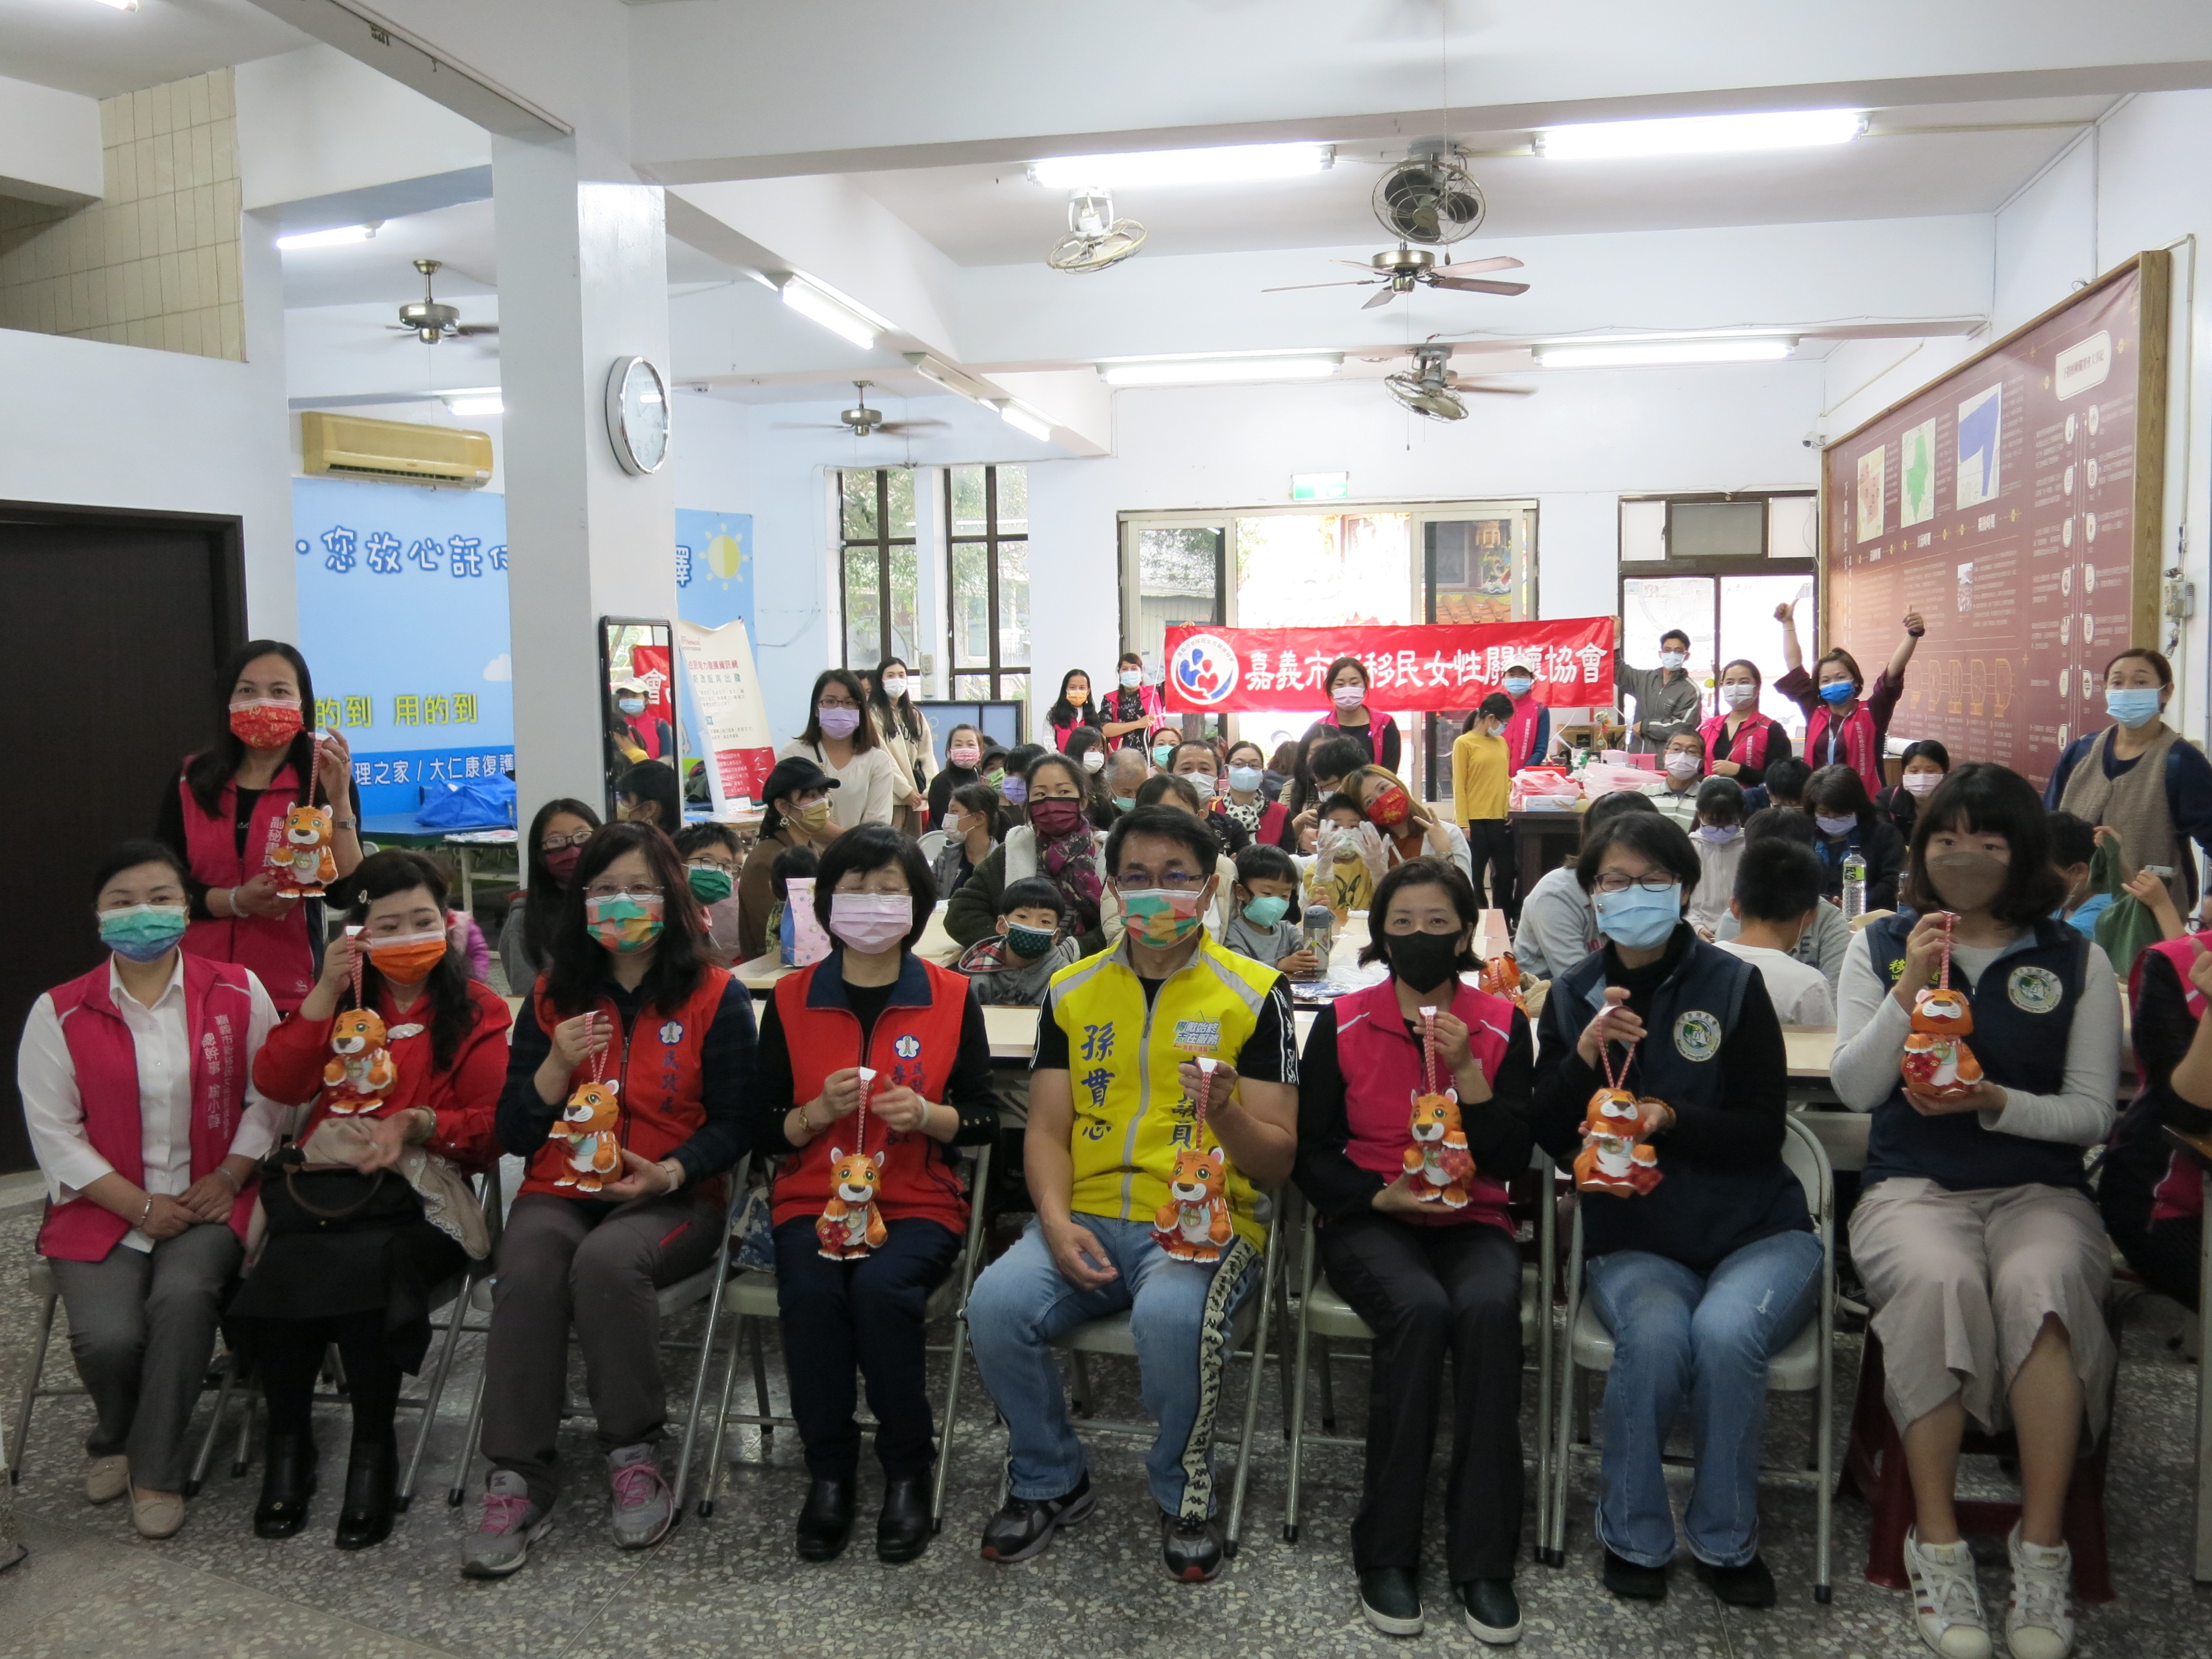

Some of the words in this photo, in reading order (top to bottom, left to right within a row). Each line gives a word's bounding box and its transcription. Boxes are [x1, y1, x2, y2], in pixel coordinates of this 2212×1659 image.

[1244, 641, 1608, 692] 嘉義市移民女性關懷協會
[394, 693, 479, 726] 用的到
[201, 1032, 221, 1076] 總幹事
[1173, 1032, 1221, 1045] 志在服務
